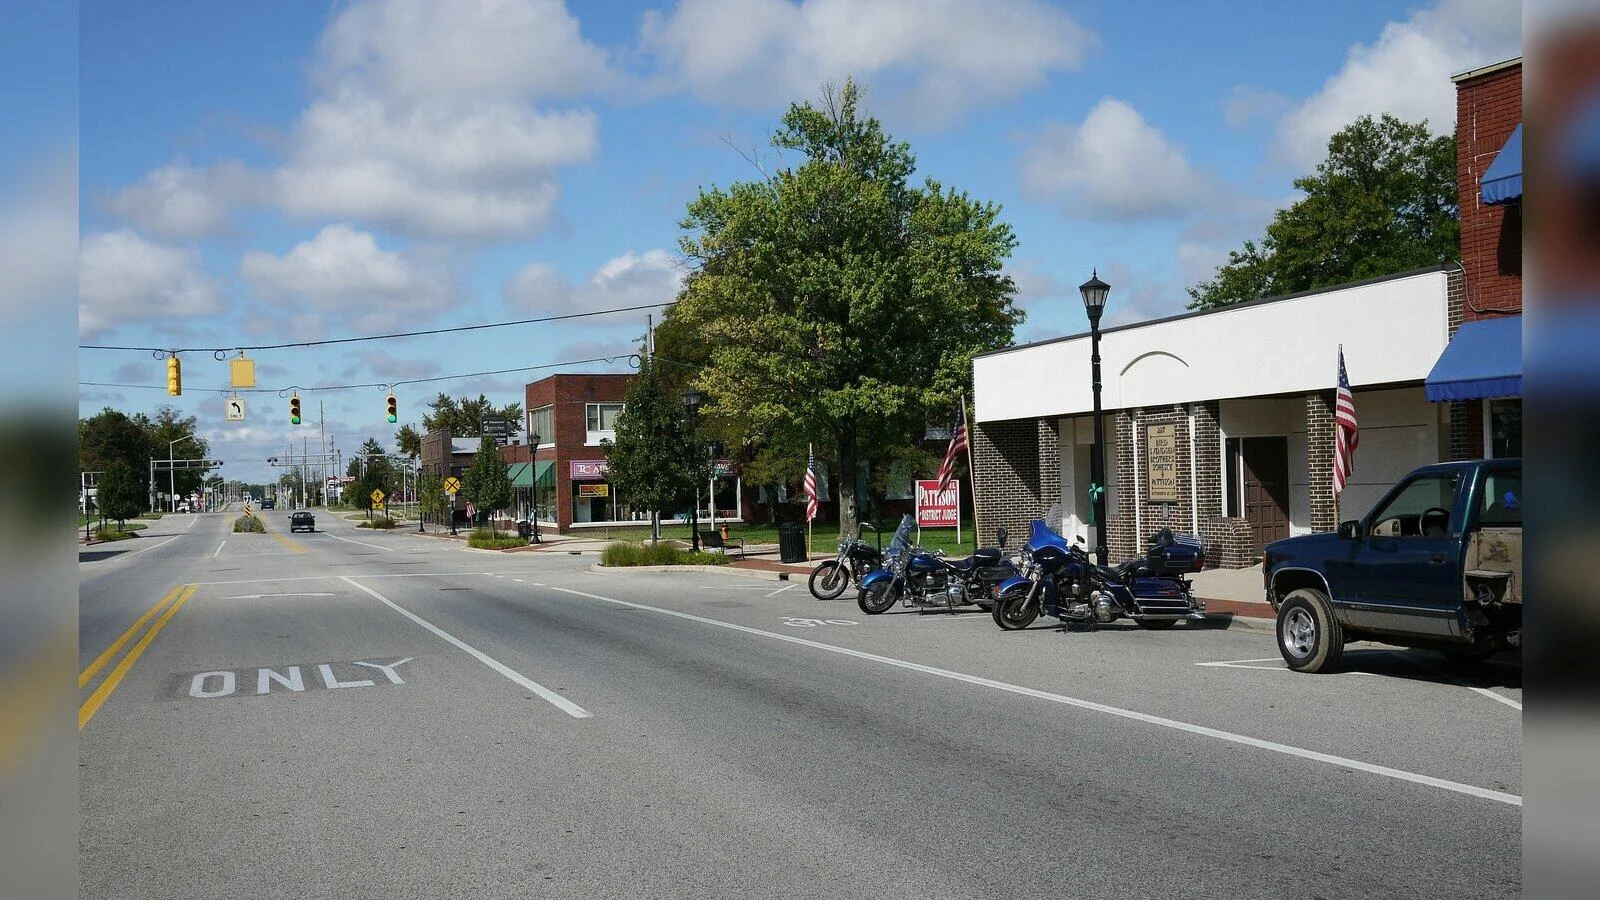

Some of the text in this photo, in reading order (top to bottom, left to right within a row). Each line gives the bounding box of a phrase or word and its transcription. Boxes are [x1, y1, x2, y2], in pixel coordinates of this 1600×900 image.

[577, 464, 590, 474] TC
[1151, 478, 1175, 486] PATTISON
[919, 485, 956, 506] PATTISON
[921, 508, 957, 521] DISTRICT JUDGE
[189, 657, 414, 698] ONLY
